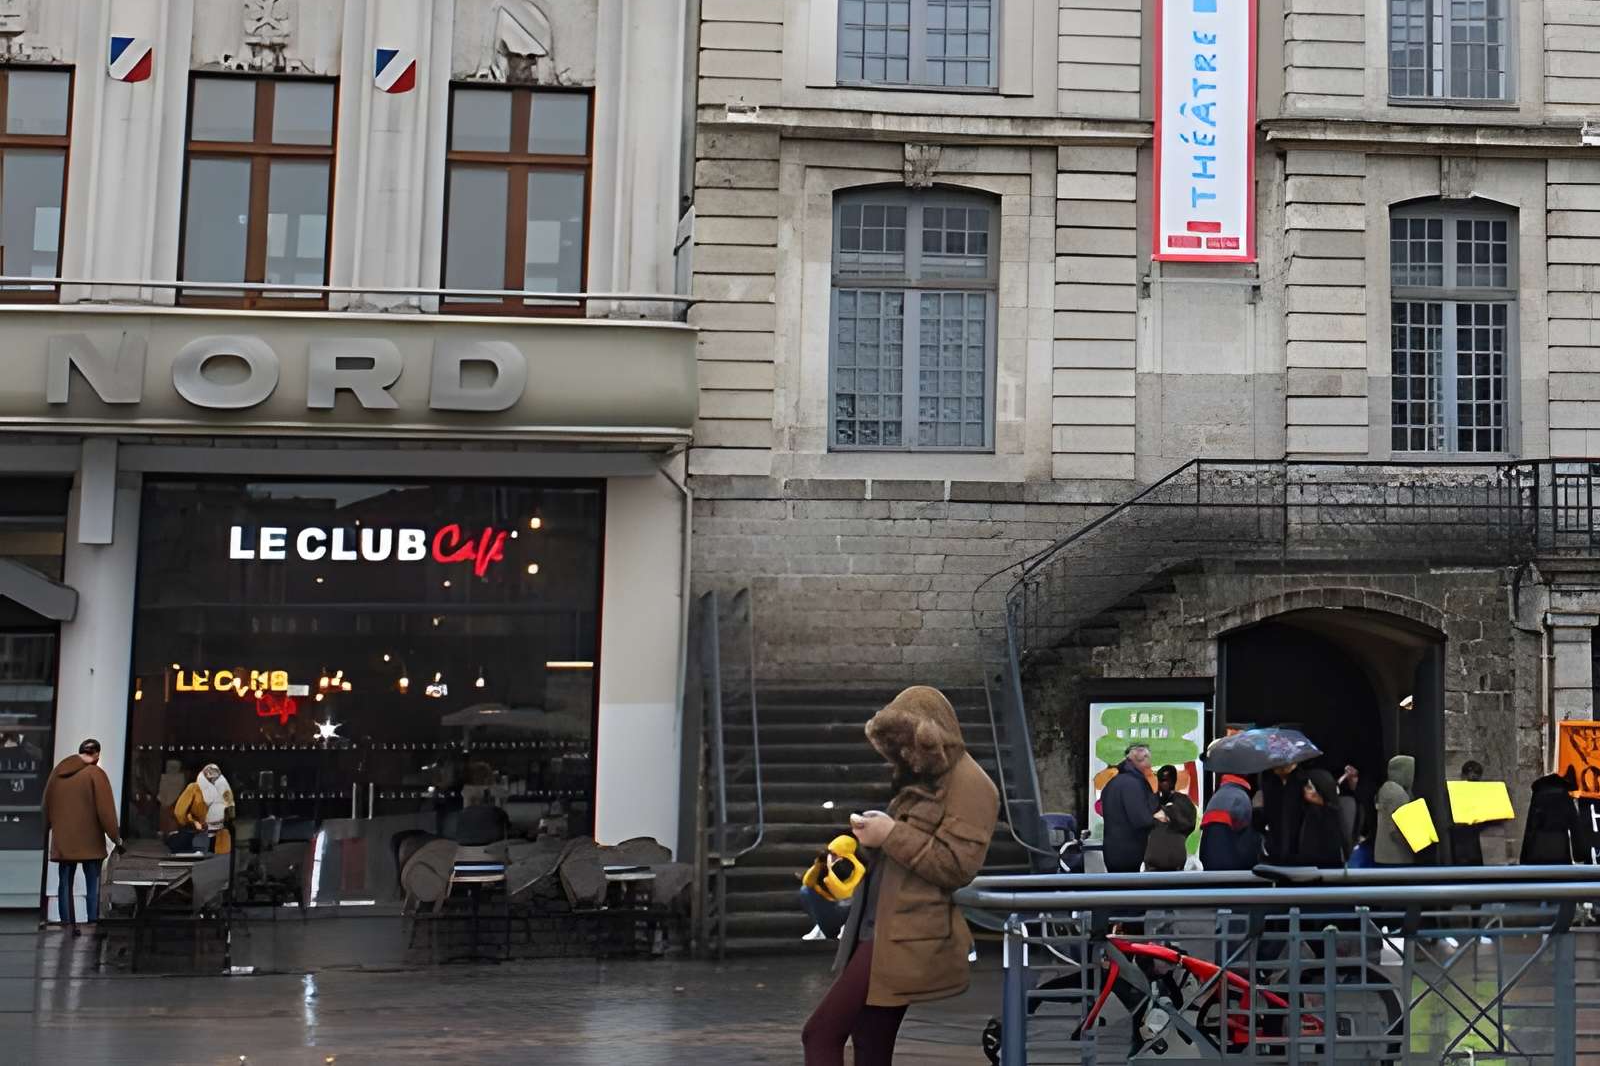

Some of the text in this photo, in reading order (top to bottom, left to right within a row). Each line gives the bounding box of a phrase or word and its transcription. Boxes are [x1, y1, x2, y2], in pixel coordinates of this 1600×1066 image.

[1180, 30, 1218, 208] THÉÂTRE
[47, 333, 527, 412] NORD
[230, 526, 287, 560] LE
[296, 527, 427, 561] CLUB
